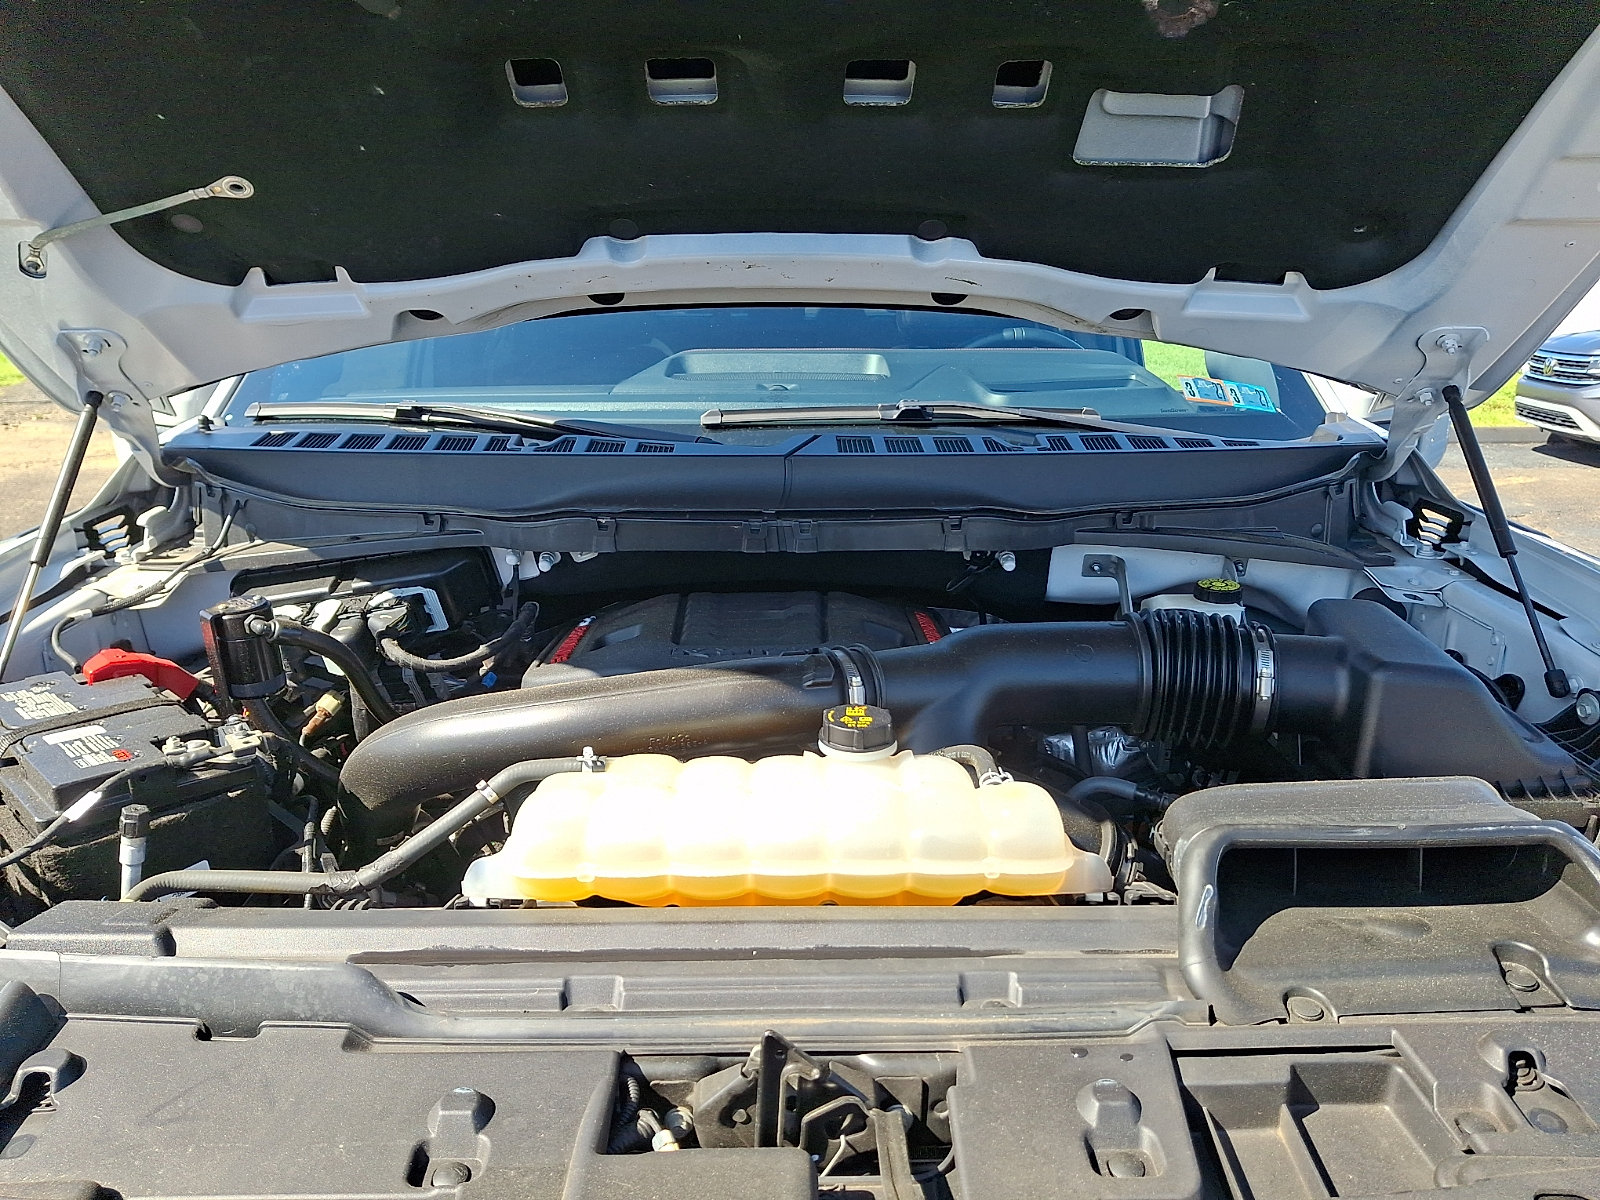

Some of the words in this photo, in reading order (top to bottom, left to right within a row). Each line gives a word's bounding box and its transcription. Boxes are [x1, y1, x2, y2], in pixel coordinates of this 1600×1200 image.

[1184, 381, 1196, 398] 3
[1211, 382, 1226, 401] 27
[1229, 388, 1241, 404] 3
[1255, 389, 1269, 408] 27
